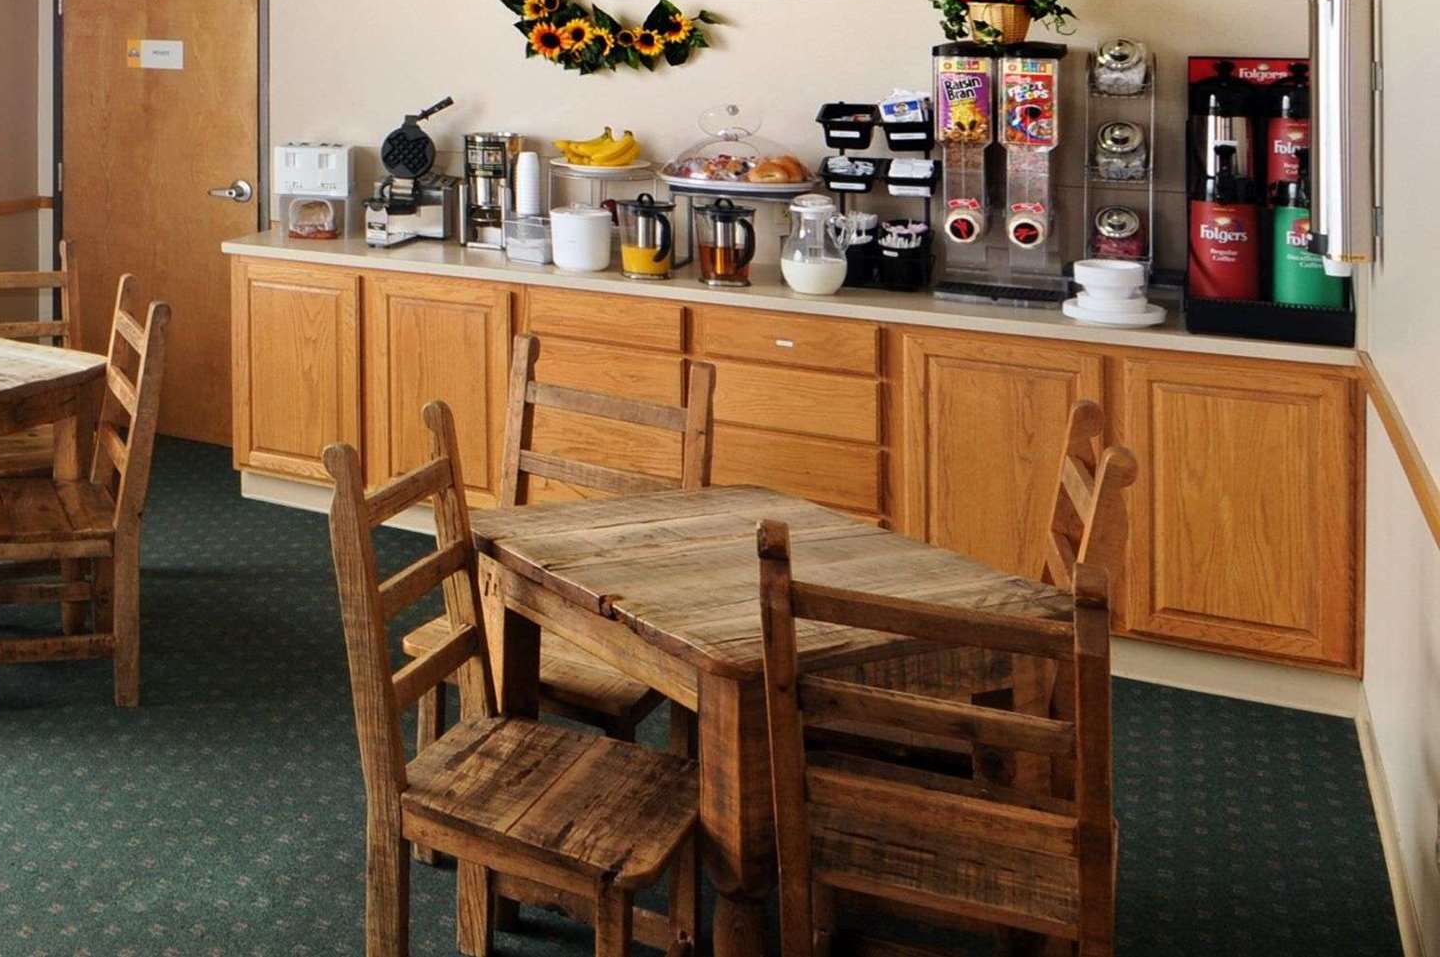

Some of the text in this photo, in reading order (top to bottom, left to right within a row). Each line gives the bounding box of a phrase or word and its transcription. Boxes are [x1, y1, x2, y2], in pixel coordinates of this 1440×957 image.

[944, 77, 981, 91] Raisin
[947, 89, 975, 101] Bran
[1200, 224, 1248, 243] Folgers
